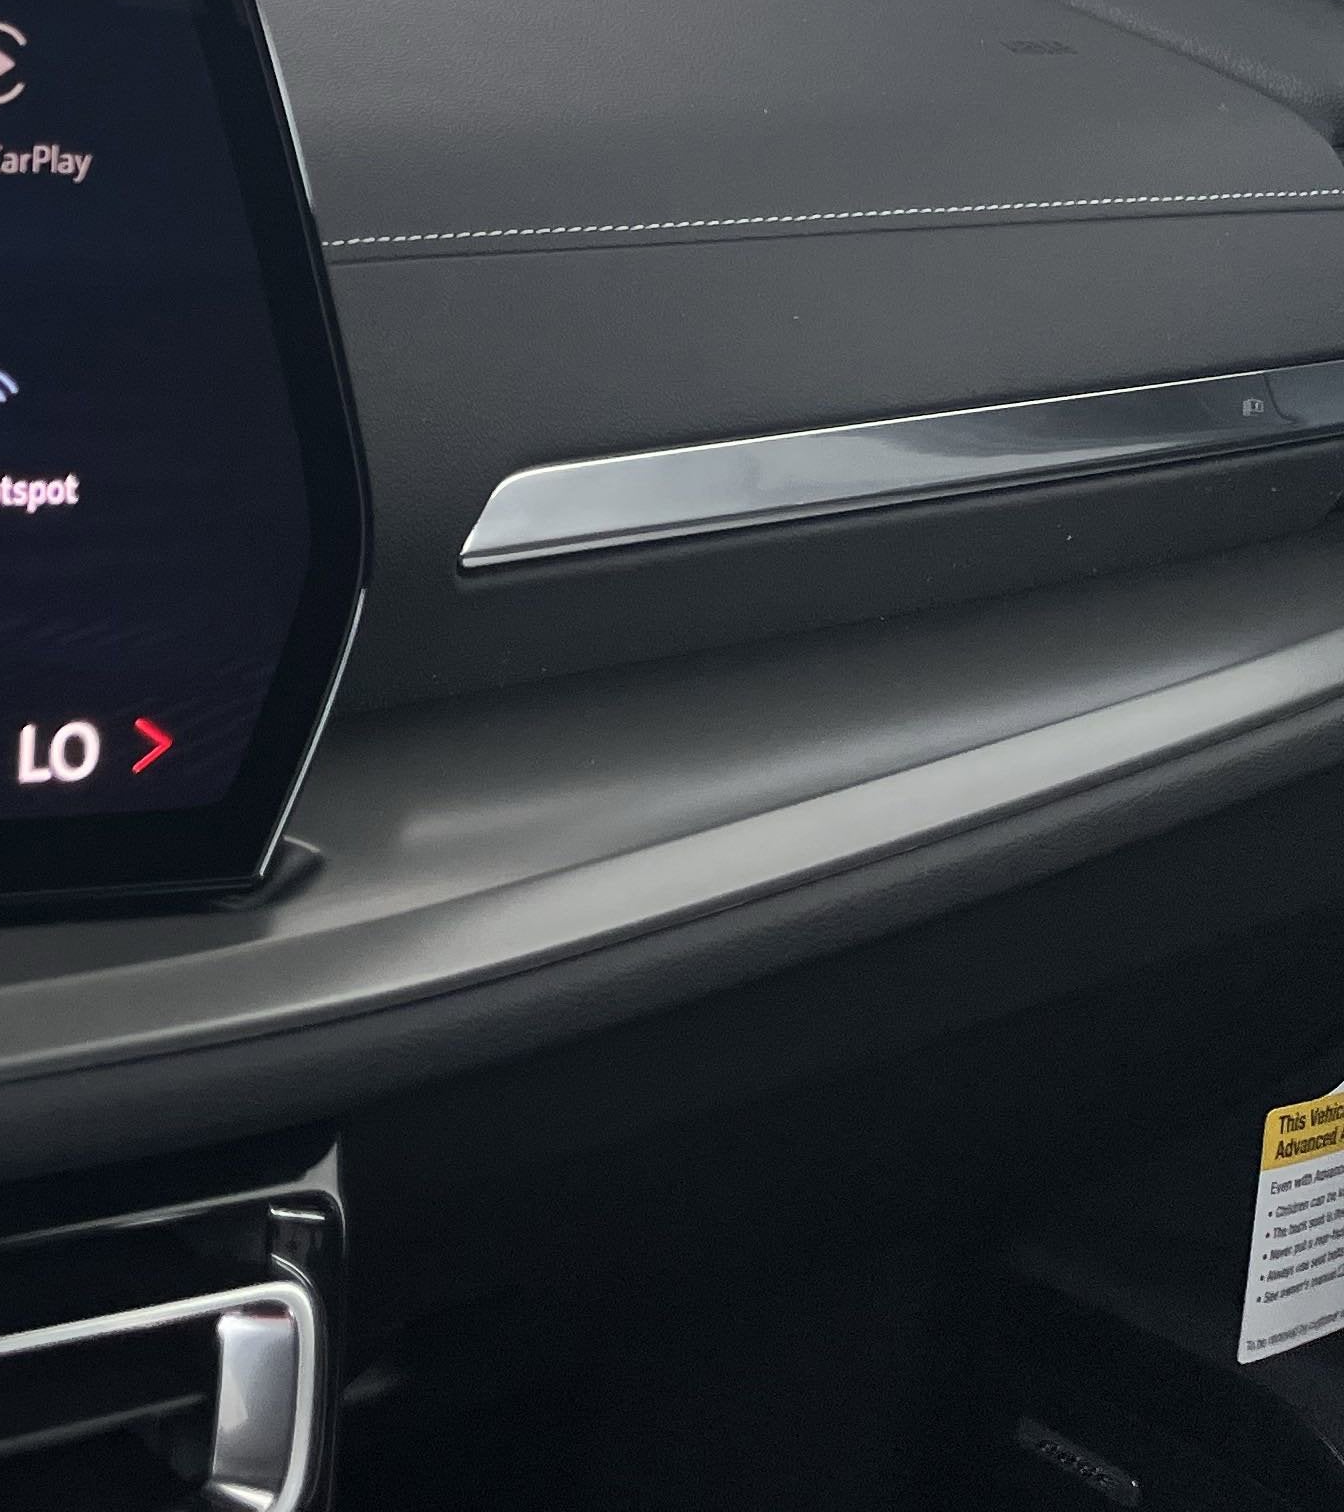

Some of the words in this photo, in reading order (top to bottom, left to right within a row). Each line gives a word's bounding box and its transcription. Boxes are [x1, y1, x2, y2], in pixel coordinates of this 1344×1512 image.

[17, 720, 101, 785] LO
[1279, 1111, 1306, 1135] This
[1274, 1126, 1337, 1160] Advanced
